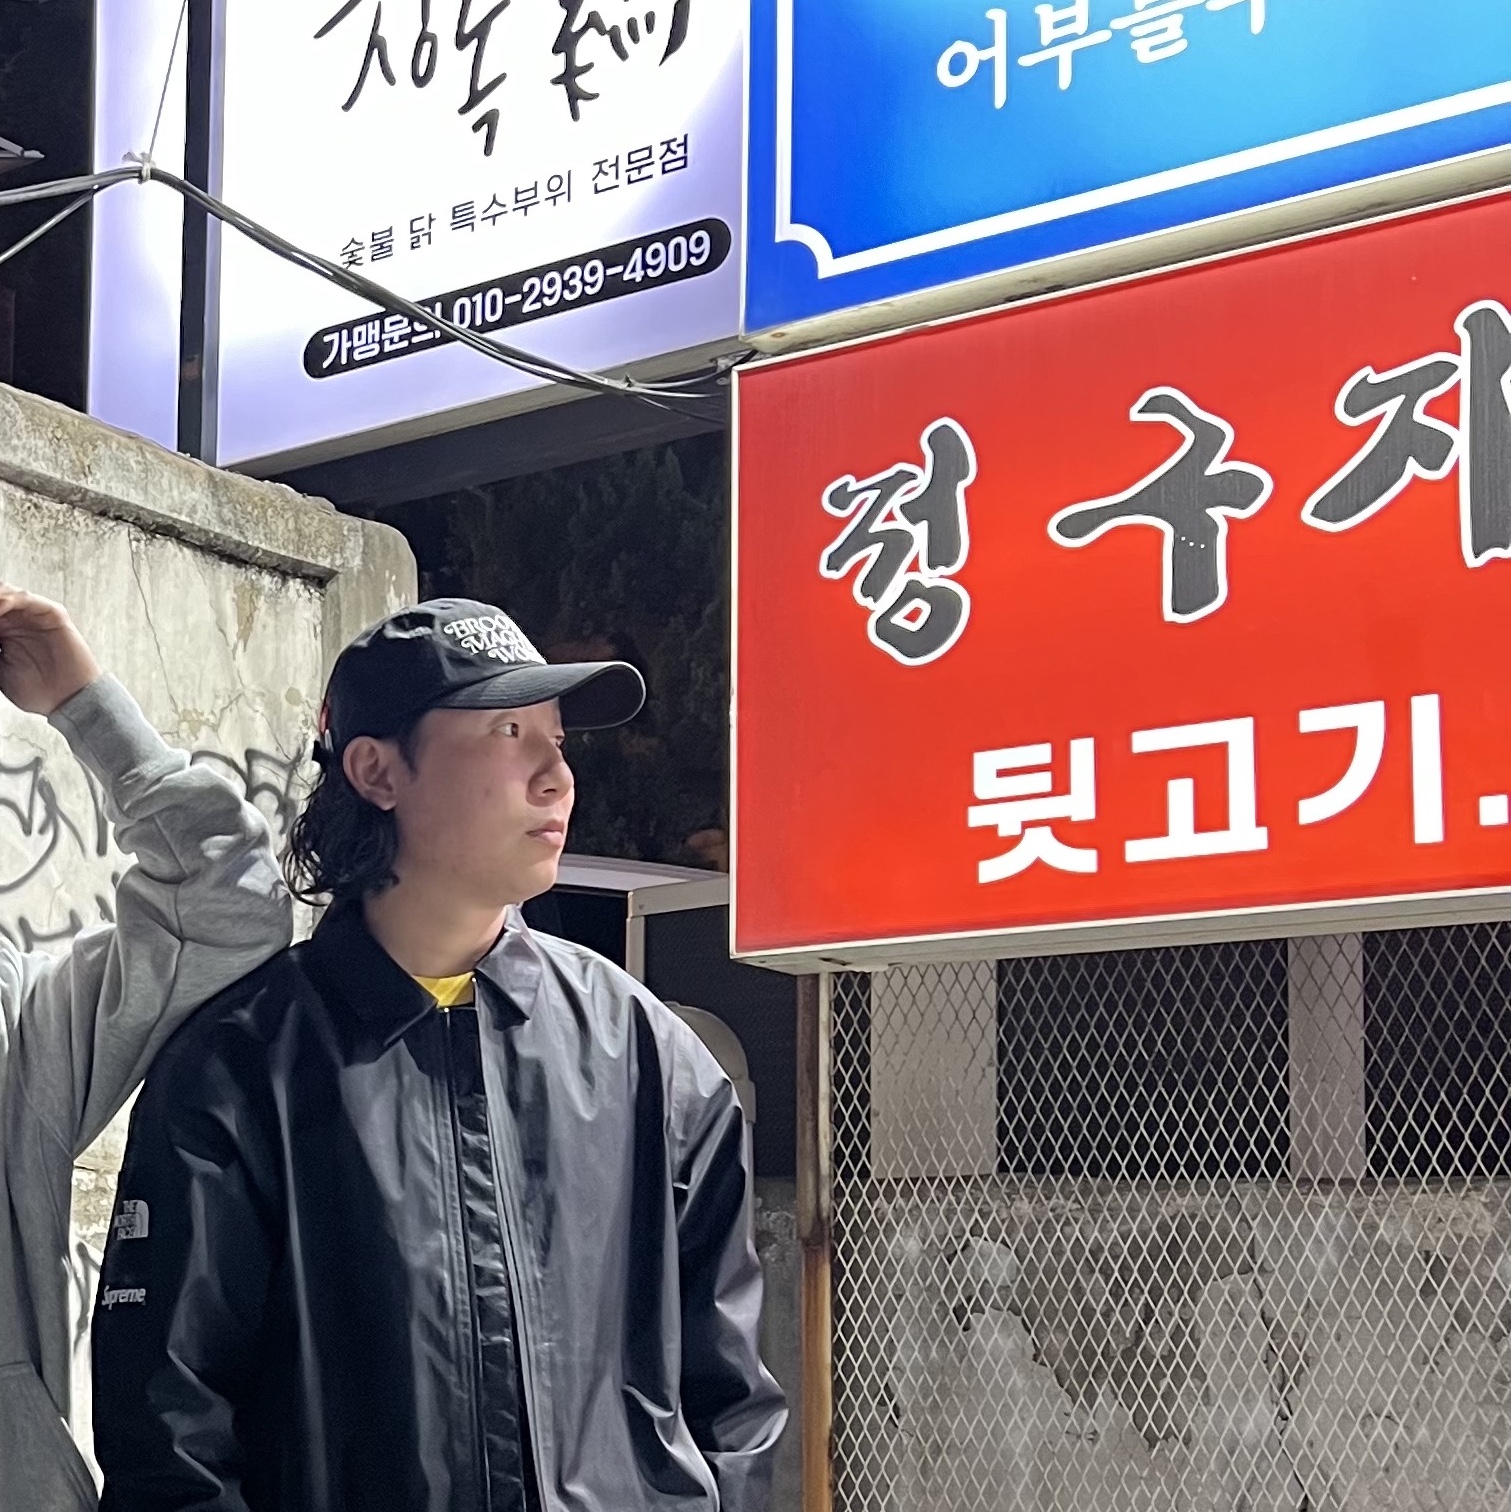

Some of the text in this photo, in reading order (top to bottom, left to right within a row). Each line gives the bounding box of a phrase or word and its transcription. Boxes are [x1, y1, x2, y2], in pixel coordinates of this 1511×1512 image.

[340, 133, 690, 268] 숯불 닭 특수부위 전문점
[452, 229, 712, 331] 010-2939-4909
[443, 614, 519, 640] BROO
